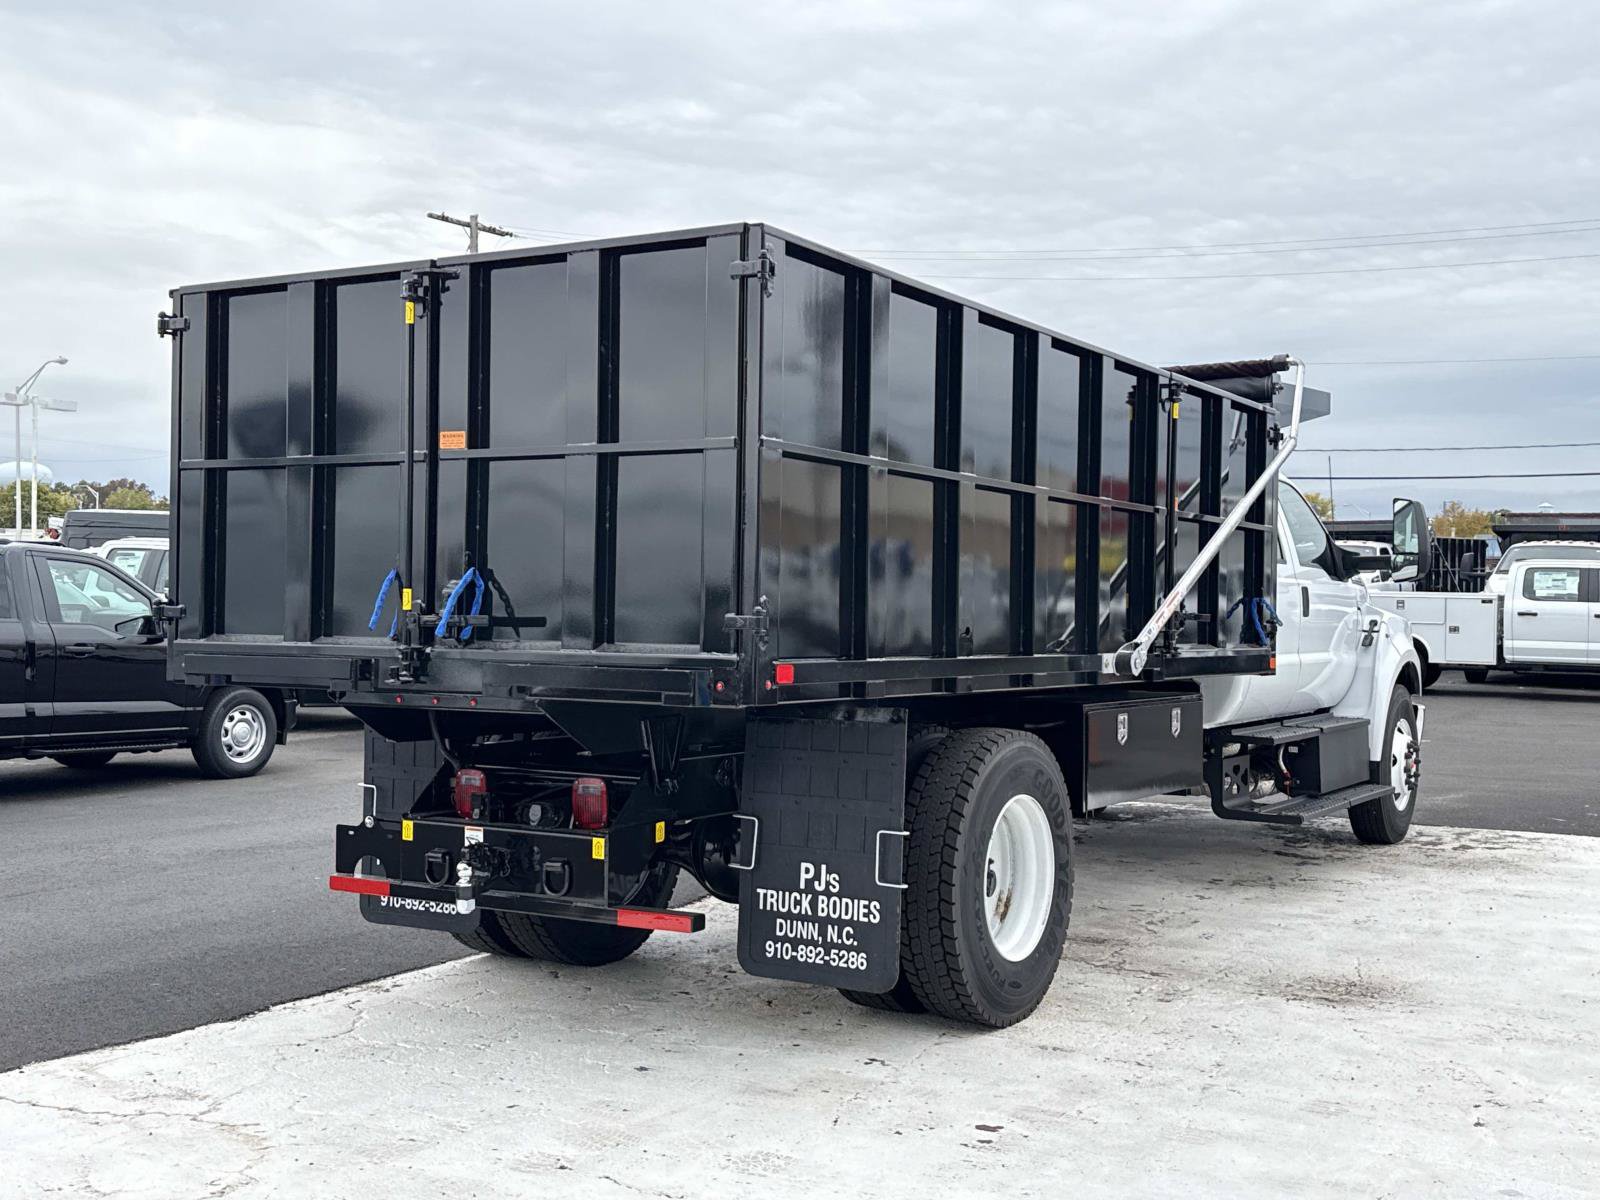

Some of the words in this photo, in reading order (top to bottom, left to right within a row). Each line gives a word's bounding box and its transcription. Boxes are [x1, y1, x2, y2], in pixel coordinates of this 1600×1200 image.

[799, 862, 840, 893] PJ's
[756, 888, 813, 916] TRUCK
[817, 895, 881, 924] BODIES
[775, 918, 823, 945] DUNN,
[827, 924, 858, 946] N.C.
[765, 940, 868, 970] 910-892-5286
